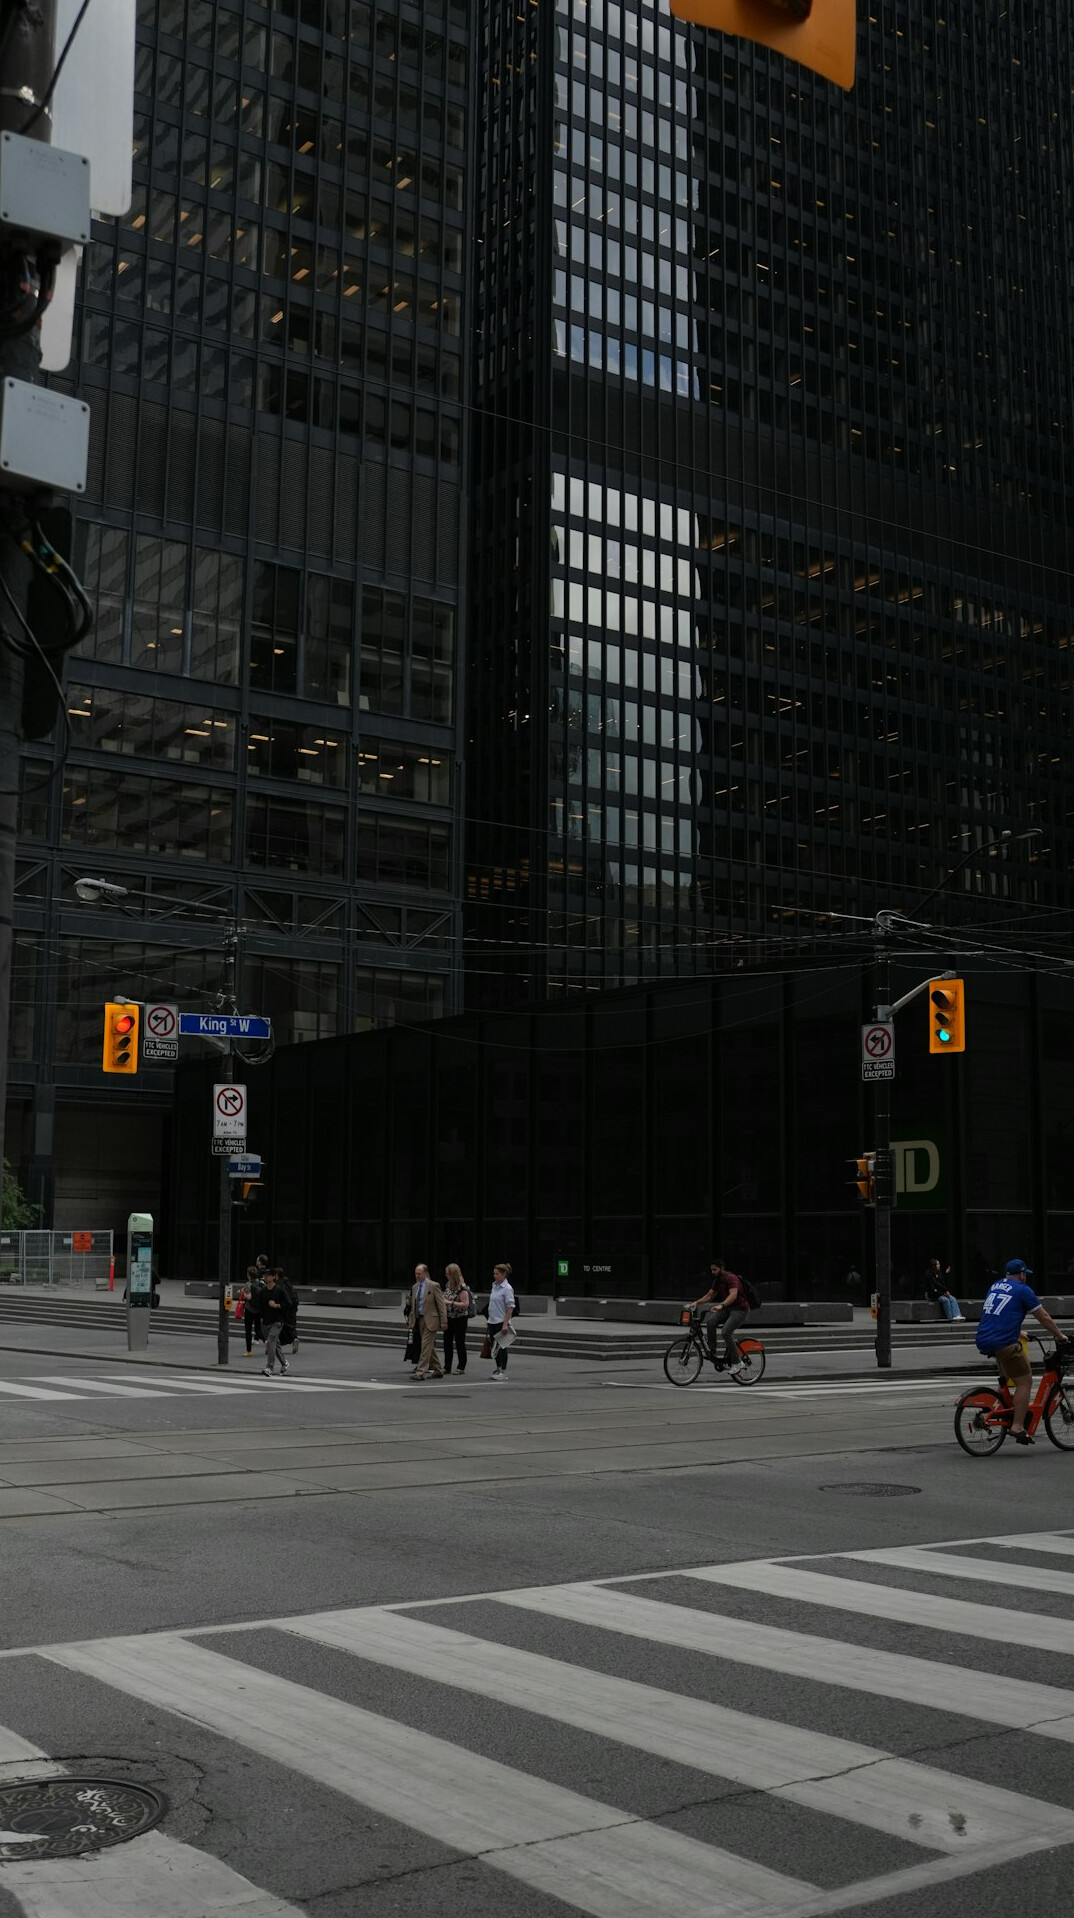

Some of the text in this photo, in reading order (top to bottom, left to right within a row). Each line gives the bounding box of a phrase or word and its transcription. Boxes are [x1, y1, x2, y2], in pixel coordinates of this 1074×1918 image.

[199, 1017, 250, 1035] King St W
[145, 1041, 178, 1051] TTC VEHICLES
[146, 1049, 176, 1058] EXCEPTED
[863, 1062, 894, 1071] TTC VEHICLES
[864, 1069, 893, 1078] EXCEPTED
[223, 1139, 245, 1147] VEHICLES
[237, 1162, 247, 1173] Bay
[888, 1139, 940, 1193] TD
[559, 1262, 569, 1273] TD
[592, 1265, 612, 1273] CENTRE
[983, 1293, 1013, 1316] 47
